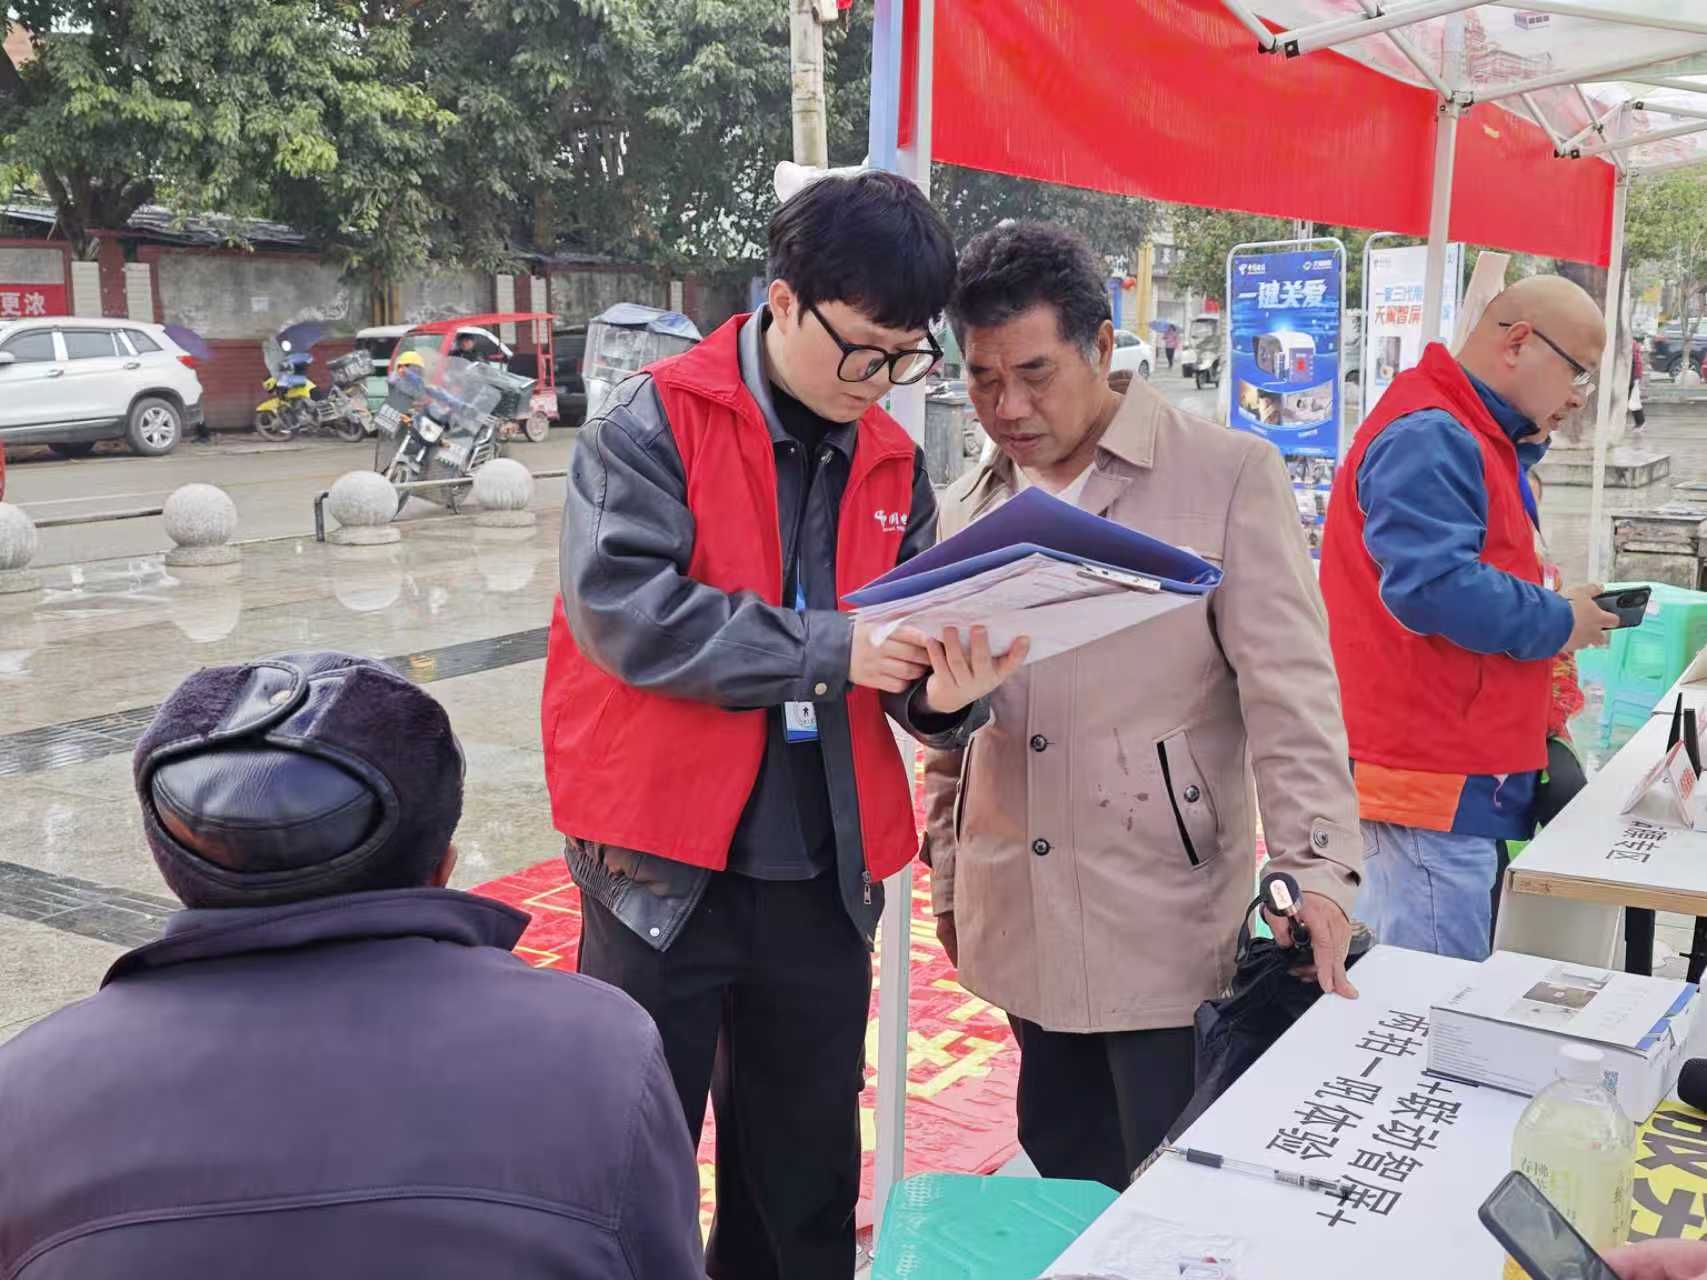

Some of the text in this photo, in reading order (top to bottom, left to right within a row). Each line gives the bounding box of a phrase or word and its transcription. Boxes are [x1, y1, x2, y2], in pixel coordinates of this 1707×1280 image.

[0, 291, 47, 316] 更浓
[1238, 279, 1328, 309] 一键关爱
